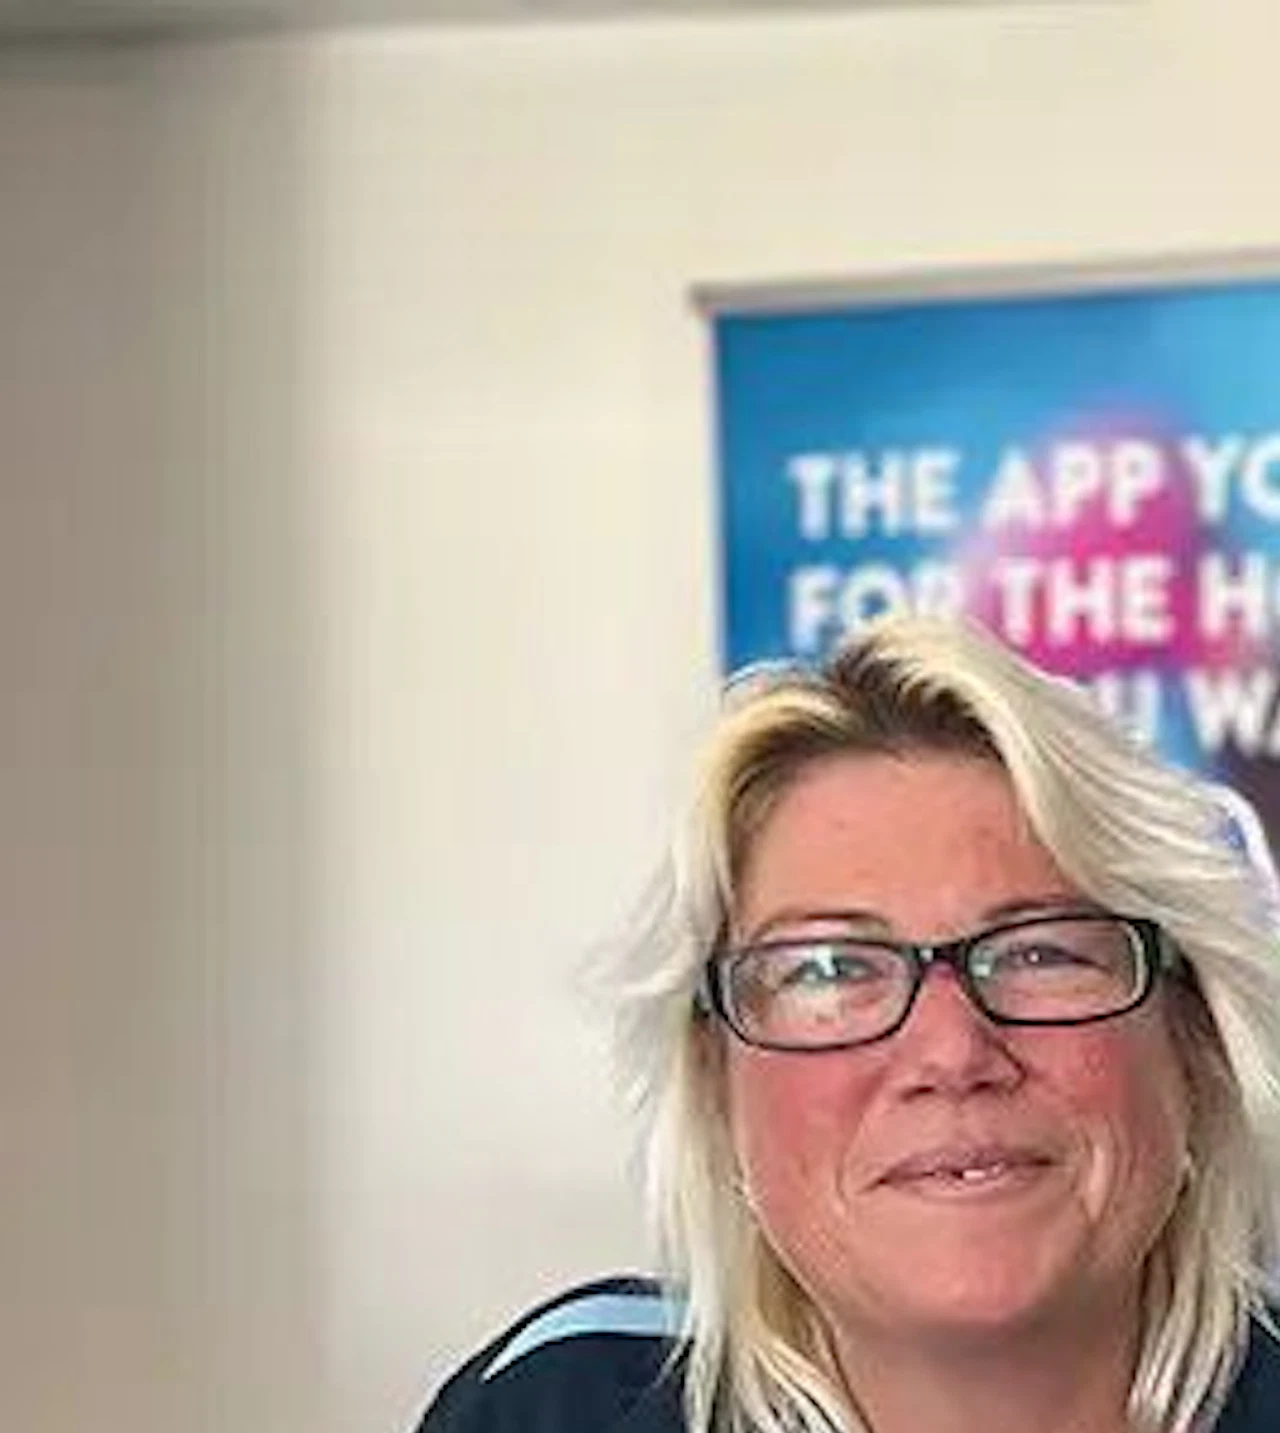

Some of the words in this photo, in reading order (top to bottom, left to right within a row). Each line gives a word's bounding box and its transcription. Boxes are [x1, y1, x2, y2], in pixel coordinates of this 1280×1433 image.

[788, 450, 962, 540] THE
[982, 438, 1166, 528] APP
[994, 553, 1178, 646] THE
